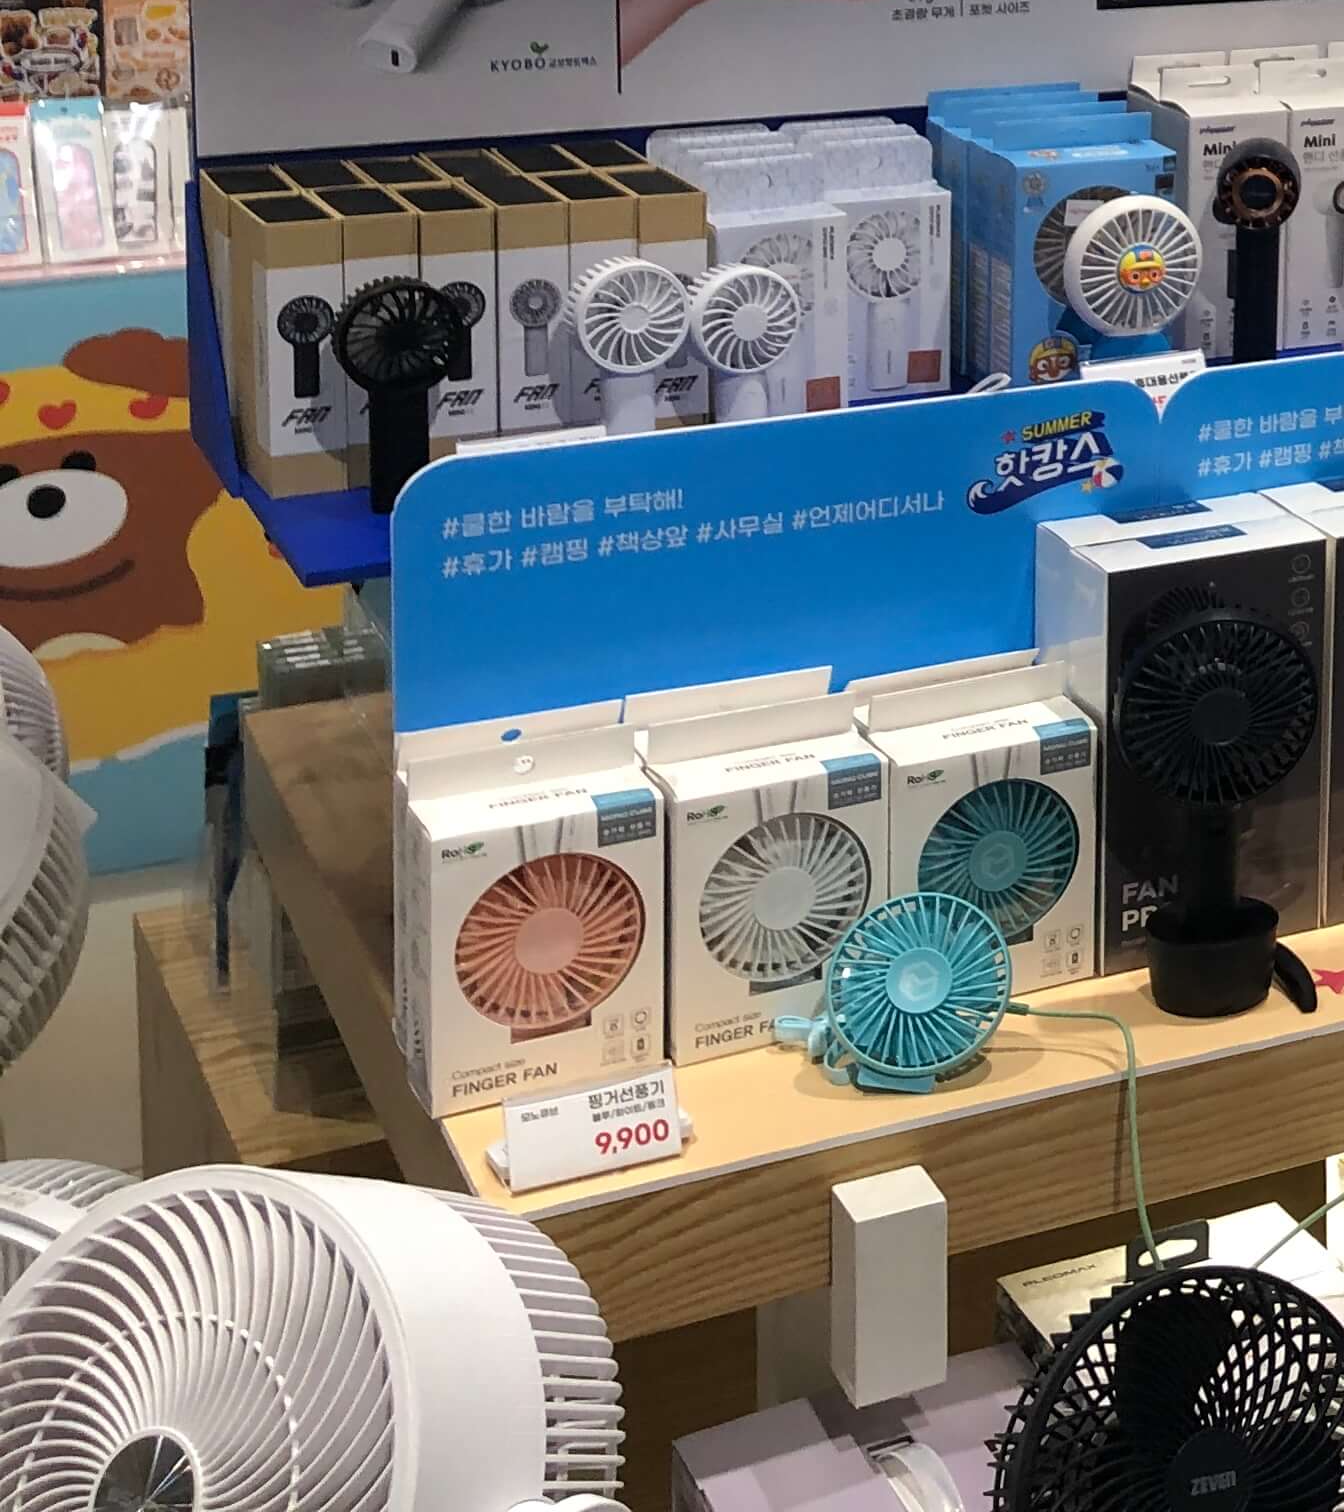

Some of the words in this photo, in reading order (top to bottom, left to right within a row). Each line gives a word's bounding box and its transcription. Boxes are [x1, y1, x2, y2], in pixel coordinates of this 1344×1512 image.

[930, 4, 956, 20] 무게
[996, 0, 1031, 16] 사이즈
[490, 57, 546, 73] KYOBO
[1304, 133, 1336, 148] Mini
[1021, 410, 1094, 442] SUMMER
[1198, 417, 1254, 443] #쿨한
[1258, 407, 1319, 435] 바람을
[994, 433, 1101, 492] 핫캉스
[1197, 452, 1253, 478] #휴가
[1258, 441, 1313, 468] #캠핑
[441, 512, 512, 540] #쿨한
[521, 499, 595, 528] 바람을
[602, 489, 684, 517] 부탁해!
[441, 551, 512, 580] #휴가
[520, 539, 589, 569] #캠핑
[597, 525, 689, 558] #책상앞
[695, 512, 785, 545] #사무실
[791, 491, 946, 529] #언제어디서나
[942, 725, 997, 739] FINGER
[1000, 719, 1029, 729] FAN
[724, 758, 783, 774] FINGER
[784, 753, 816, 764] FAN
[488, 794, 548, 810] FINGER
[552, 788, 588, 800] FAN
[1122, 874, 1179, 905] FAN
[694, 1025, 754, 1049] FINGER
[759, 1018, 776, 1034] FA
[695, 1017, 739, 1034] Compact
[742, 1011, 761, 1021] size
[452, 1064, 501, 1081] Compact
[504, 1058, 525, 1069] size
[452, 1073, 518, 1097] FINGER
[523, 1061, 559, 1081] FAN
[588, 1079, 665, 1110] 핑거선풍기
[595, 1119, 670, 1155] 9,900
